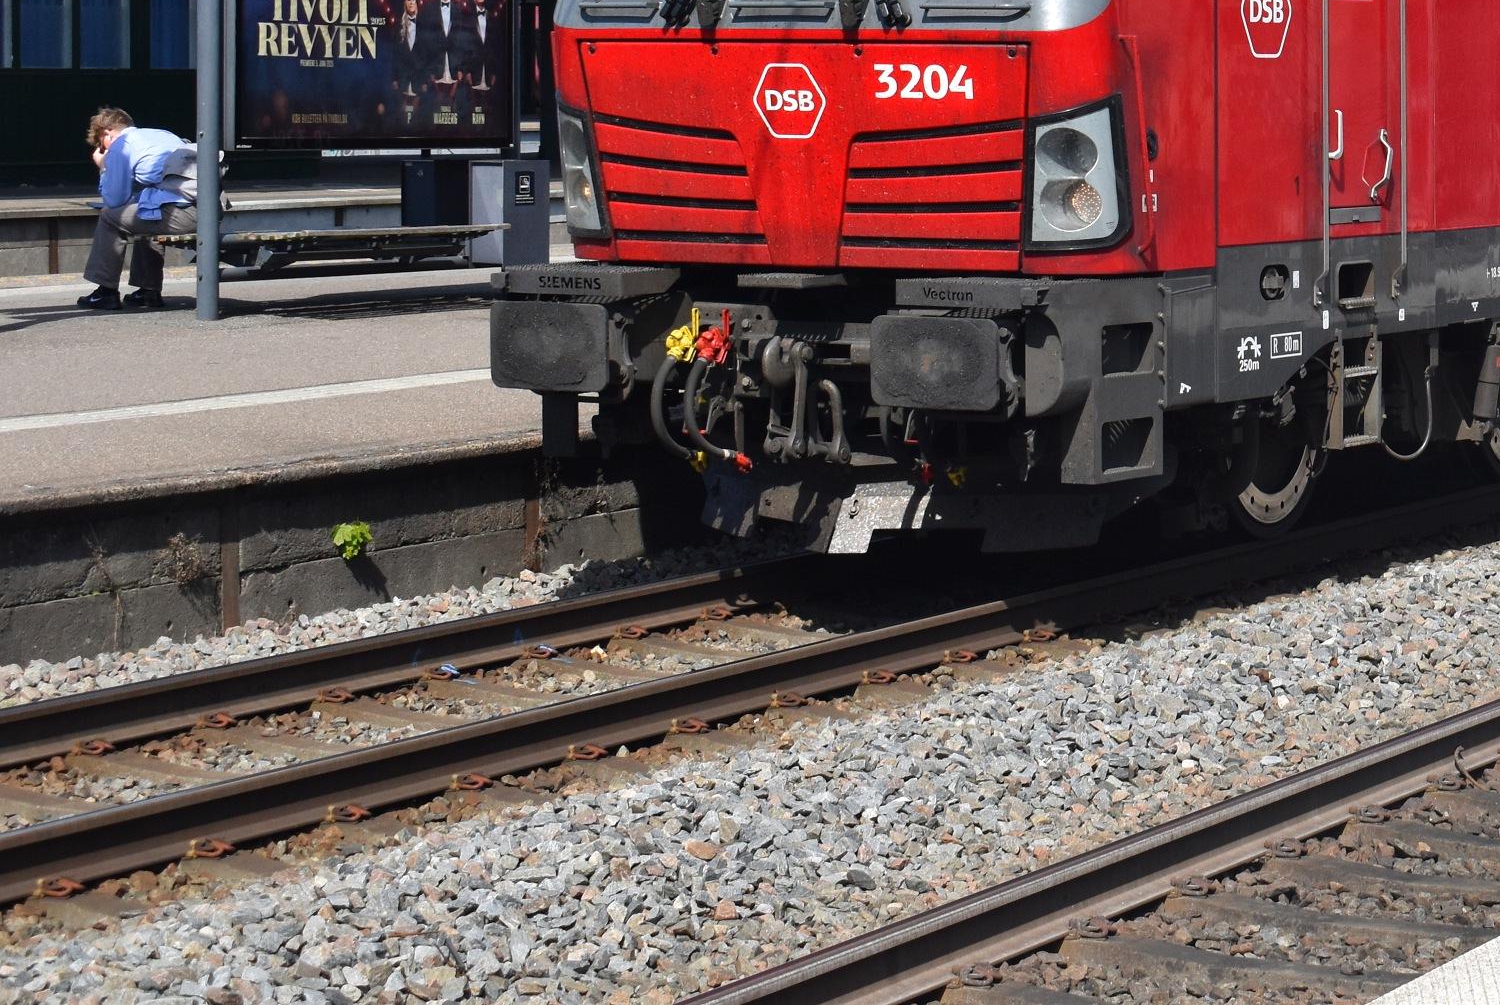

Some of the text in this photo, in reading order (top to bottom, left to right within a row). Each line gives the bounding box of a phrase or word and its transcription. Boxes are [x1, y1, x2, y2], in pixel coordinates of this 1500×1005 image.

[257, 21, 378, 60] REVYEN
[873, 63, 974, 100] 3204
[764, 89, 815, 112] DSB
[538, 276, 601, 290] SIEMENS
[923, 287, 973, 301] Vectron
[1273, 338, 1279, 354] R
[1239, 359, 1260, 372] 250m
